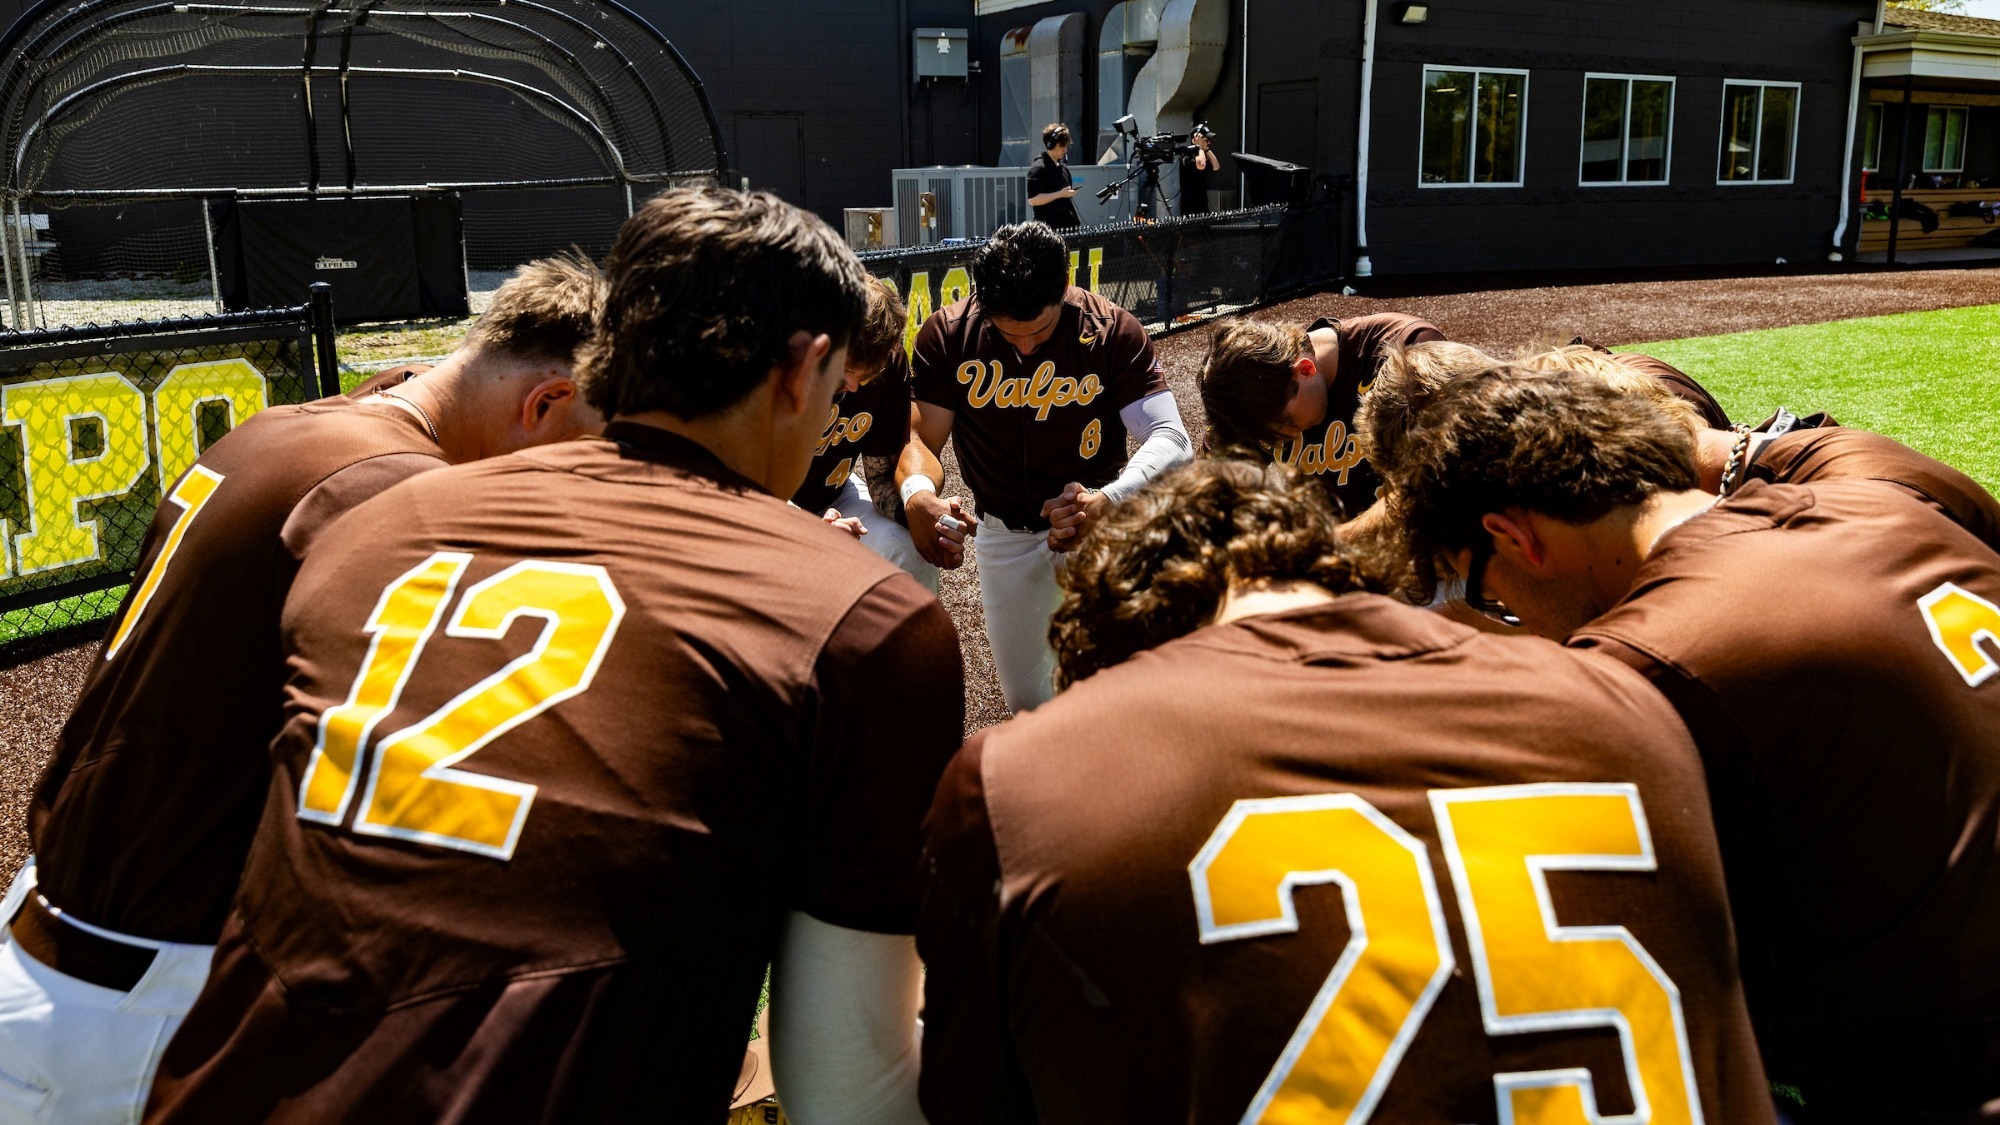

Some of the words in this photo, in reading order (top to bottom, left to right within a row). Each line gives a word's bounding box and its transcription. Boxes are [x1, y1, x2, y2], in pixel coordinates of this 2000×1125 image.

[315, 261, 357, 269] EXPRESS
[957, 359, 1104, 421] Valpo
[0, 358, 268, 580] PO
[1079, 418, 1102, 460] 8
[825, 457, 853, 490] 4
[296, 551, 626, 861] 12
[1188, 782, 1705, 1125] 25
